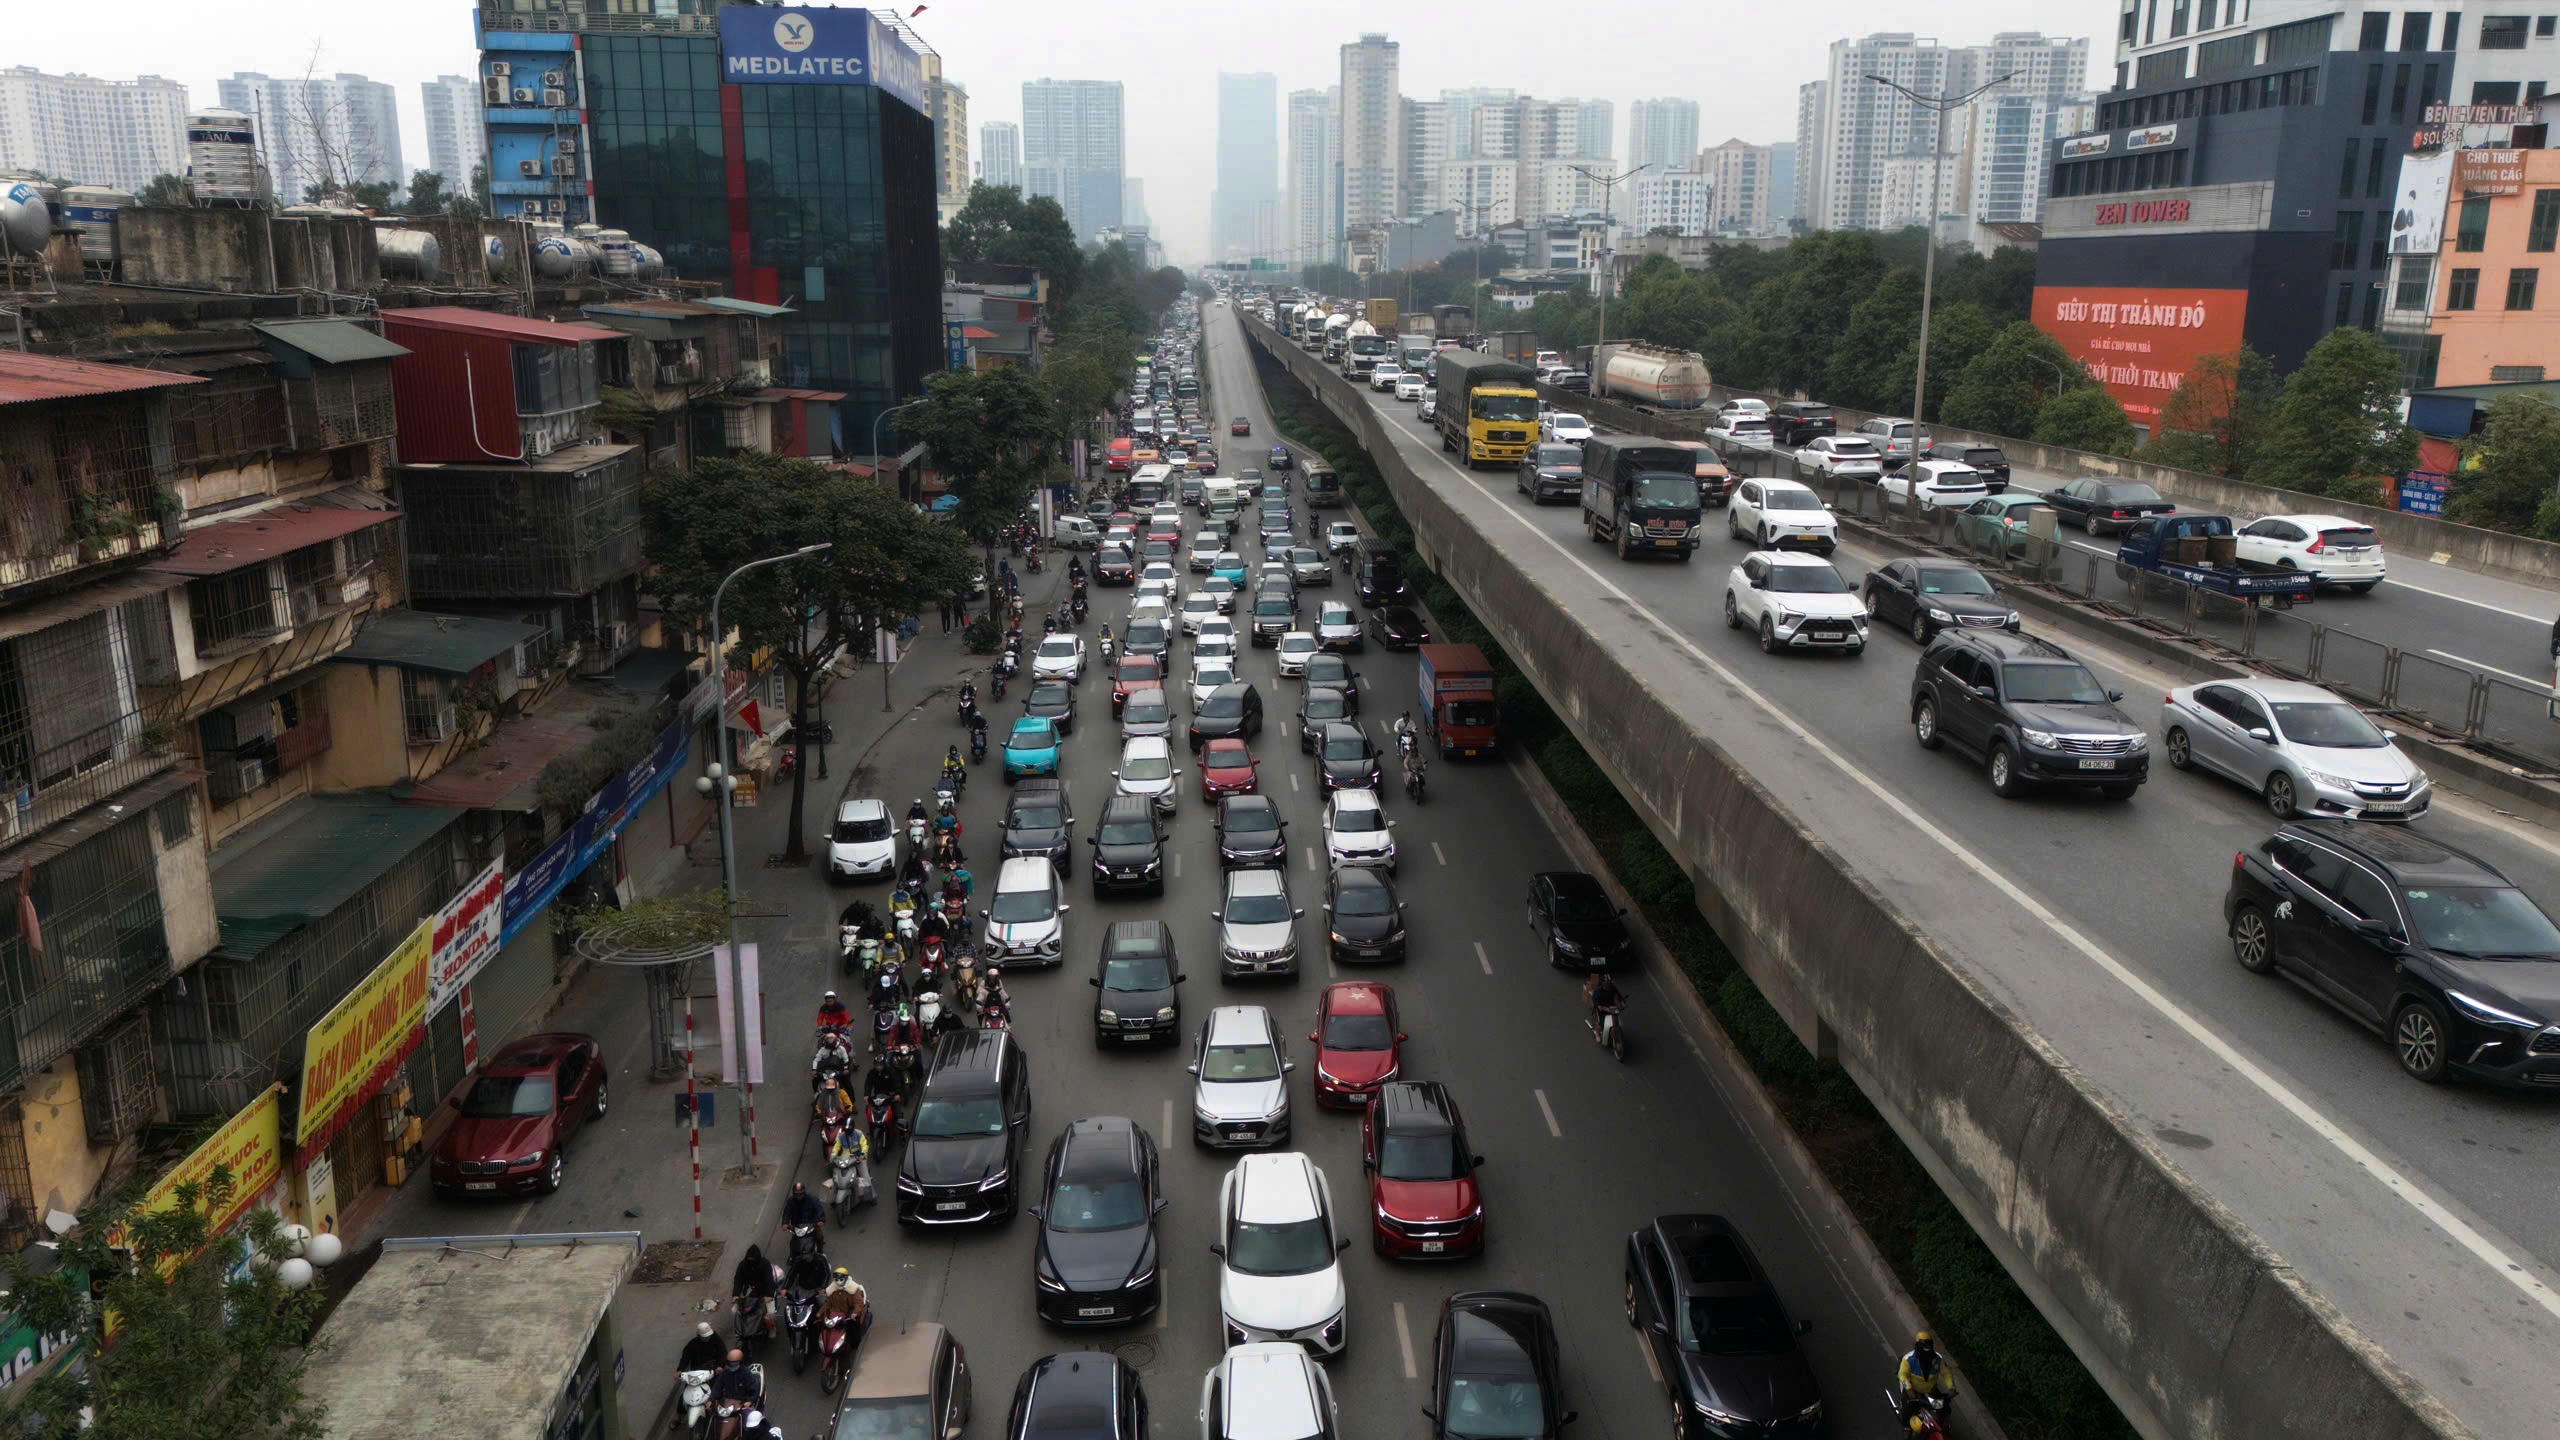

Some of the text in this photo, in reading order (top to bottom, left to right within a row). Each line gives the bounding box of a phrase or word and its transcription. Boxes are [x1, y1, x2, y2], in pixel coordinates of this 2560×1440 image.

[729, 56, 863, 75] MEDLATEC
[2467, 150, 2519, 163] CHO THUÊ
[2095, 199, 2190, 225] ZEN TOWER
[2057, 297, 2205, 328] SIÊU THỊ THÀNH ĐÔ
[444, 932, 488, 981] HONDA
[305, 1040, 338, 1114] BÁCH
[341, 1015, 363, 1079] HÓA
[242, 1148, 273, 1185] HỢP
